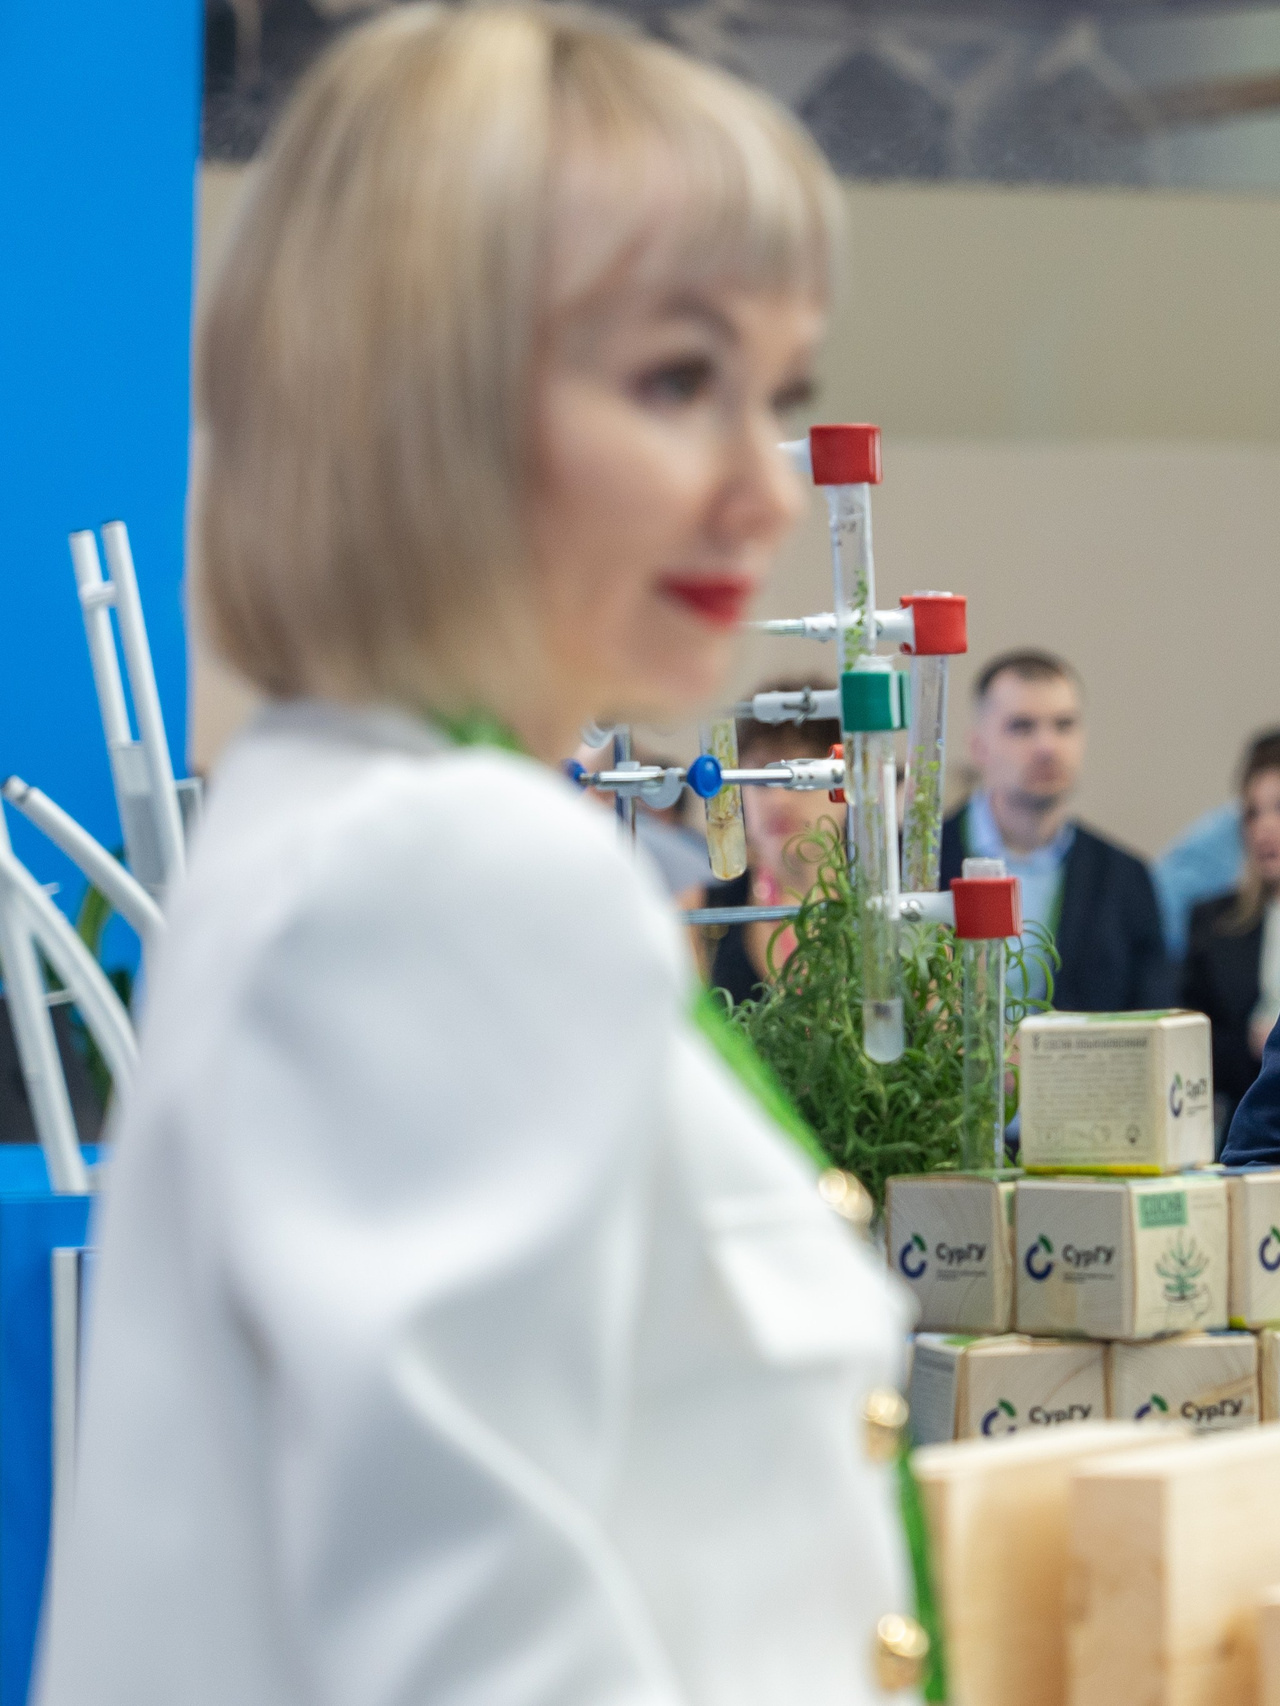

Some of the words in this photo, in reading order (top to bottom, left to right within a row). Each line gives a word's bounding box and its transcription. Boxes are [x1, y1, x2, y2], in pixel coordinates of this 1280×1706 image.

[935, 1243, 987, 1265] СурГУ
[1062, 1244, 1115, 1267] СурГУ
[1181, 1399, 1244, 1424] СурГУ
